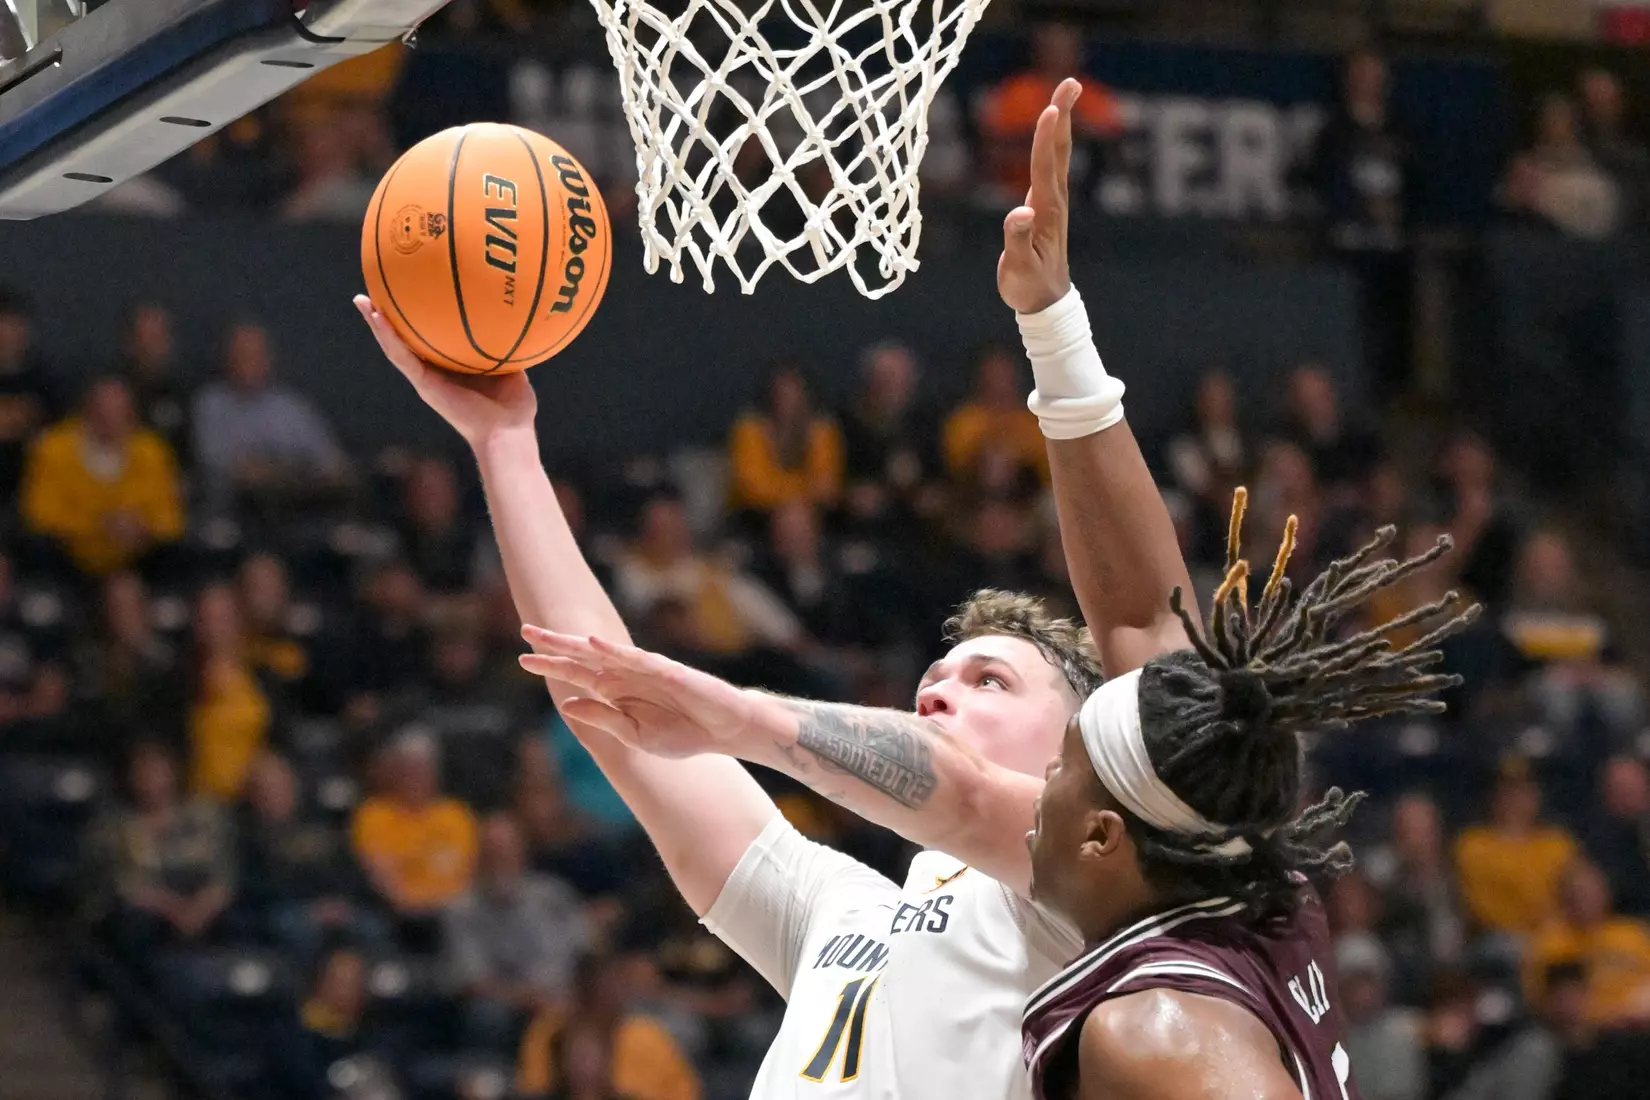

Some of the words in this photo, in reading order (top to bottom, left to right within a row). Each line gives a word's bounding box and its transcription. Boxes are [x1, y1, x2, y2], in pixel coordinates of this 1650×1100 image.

[482, 173, 517, 273] EVO
[503, 275, 516, 308] NXT
[549, 154, 596, 315] Wilson
[799, 975, 880, 1083] 11
